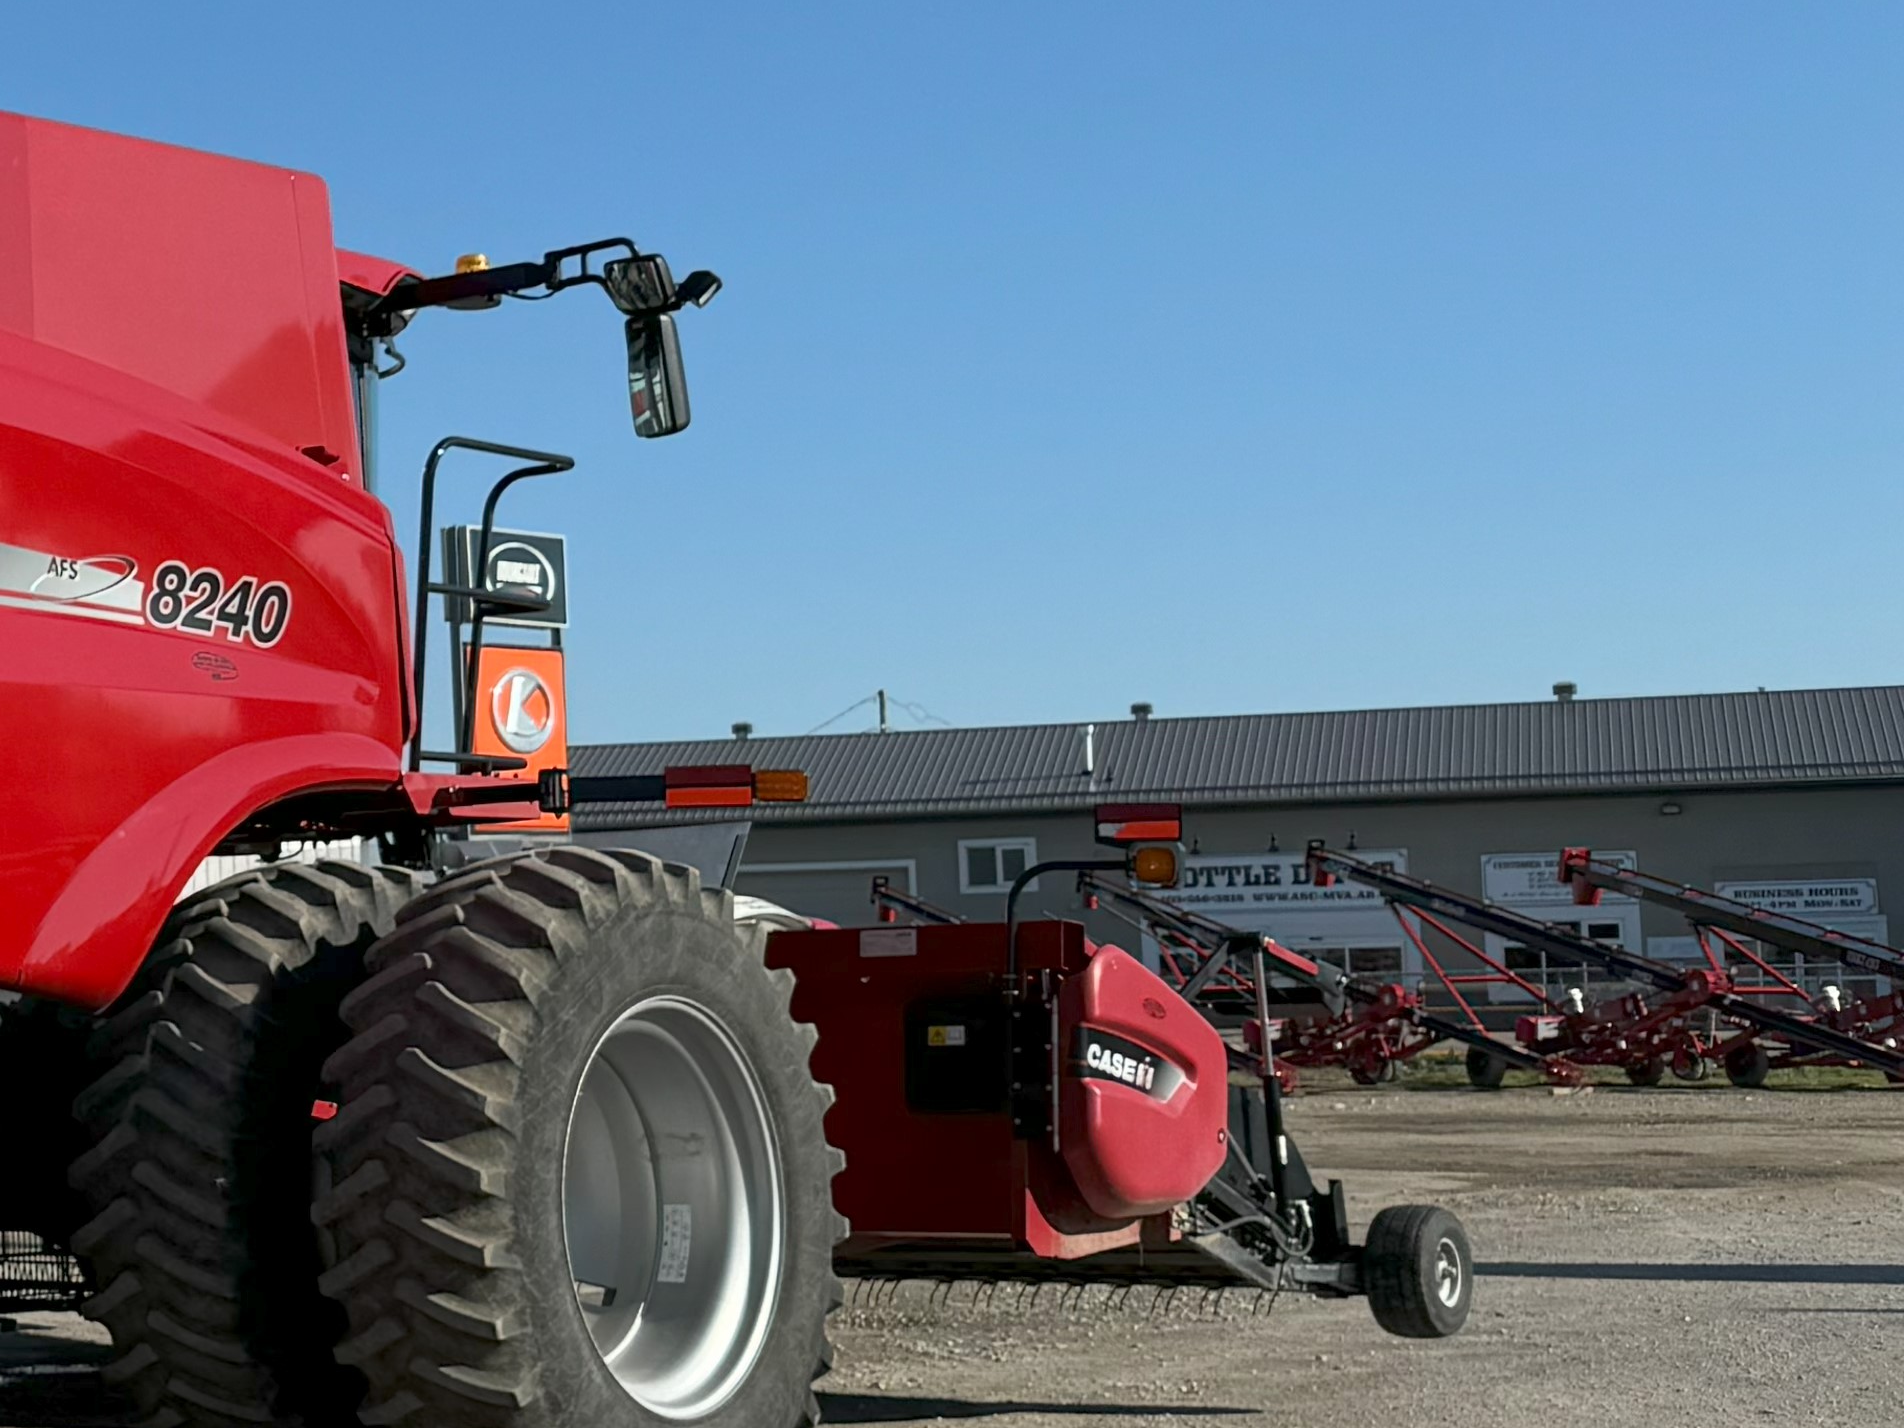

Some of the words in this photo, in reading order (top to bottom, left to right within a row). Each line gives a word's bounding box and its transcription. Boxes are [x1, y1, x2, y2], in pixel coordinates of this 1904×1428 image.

[46, 555, 79, 580] AFS
[148, 561, 291, 647] 8240
[1183, 864, 1282, 889] OTTLE
[1807, 886, 1859, 898] HOURS
[1086, 1043, 1138, 1084] CASE
